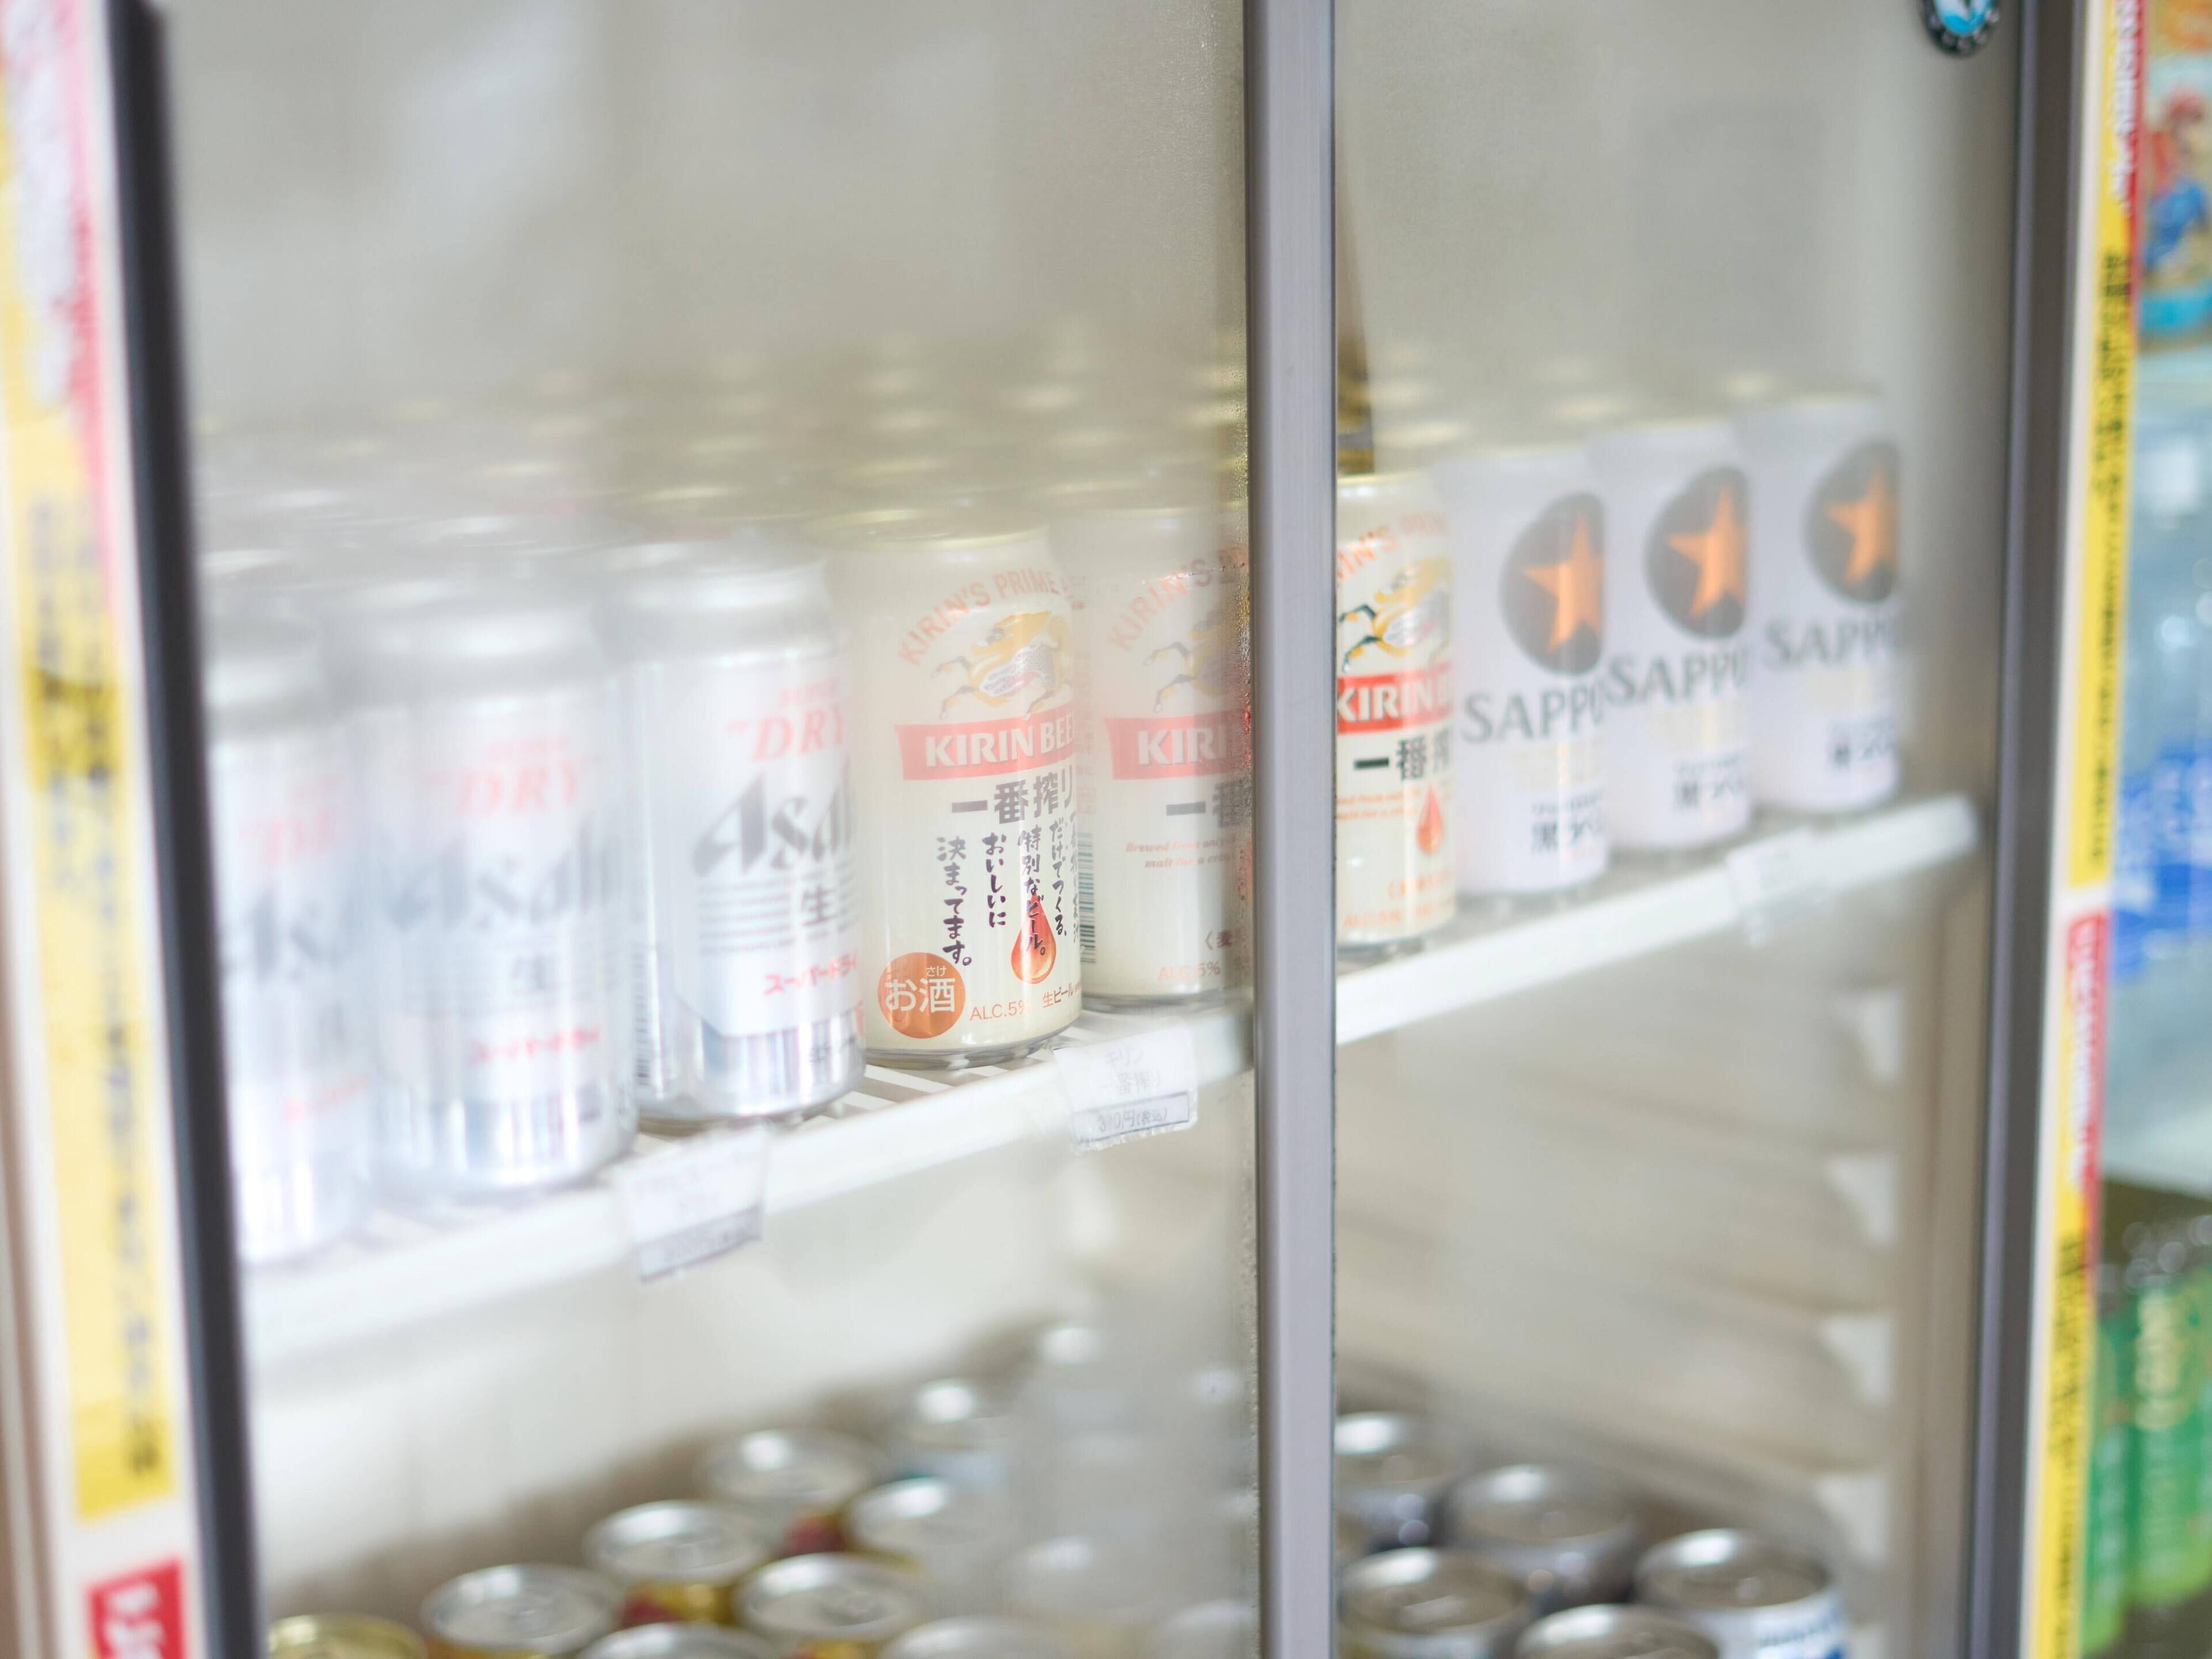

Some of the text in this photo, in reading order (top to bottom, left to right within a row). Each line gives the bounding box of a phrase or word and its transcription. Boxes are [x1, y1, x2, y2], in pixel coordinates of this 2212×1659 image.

[897, 581, 991, 666] KIRIN'S
[993, 567, 1060, 599] PRIME
[926, 724, 1034, 768] KIRIN
[952, 770, 1074, 824] 一番搾り
[936, 835, 972, 966] 決まってます。
[982, 832, 1007, 928] おいしいに
[884, 978, 956, 1014] お酒
[926, 965, 948, 978] さけ
